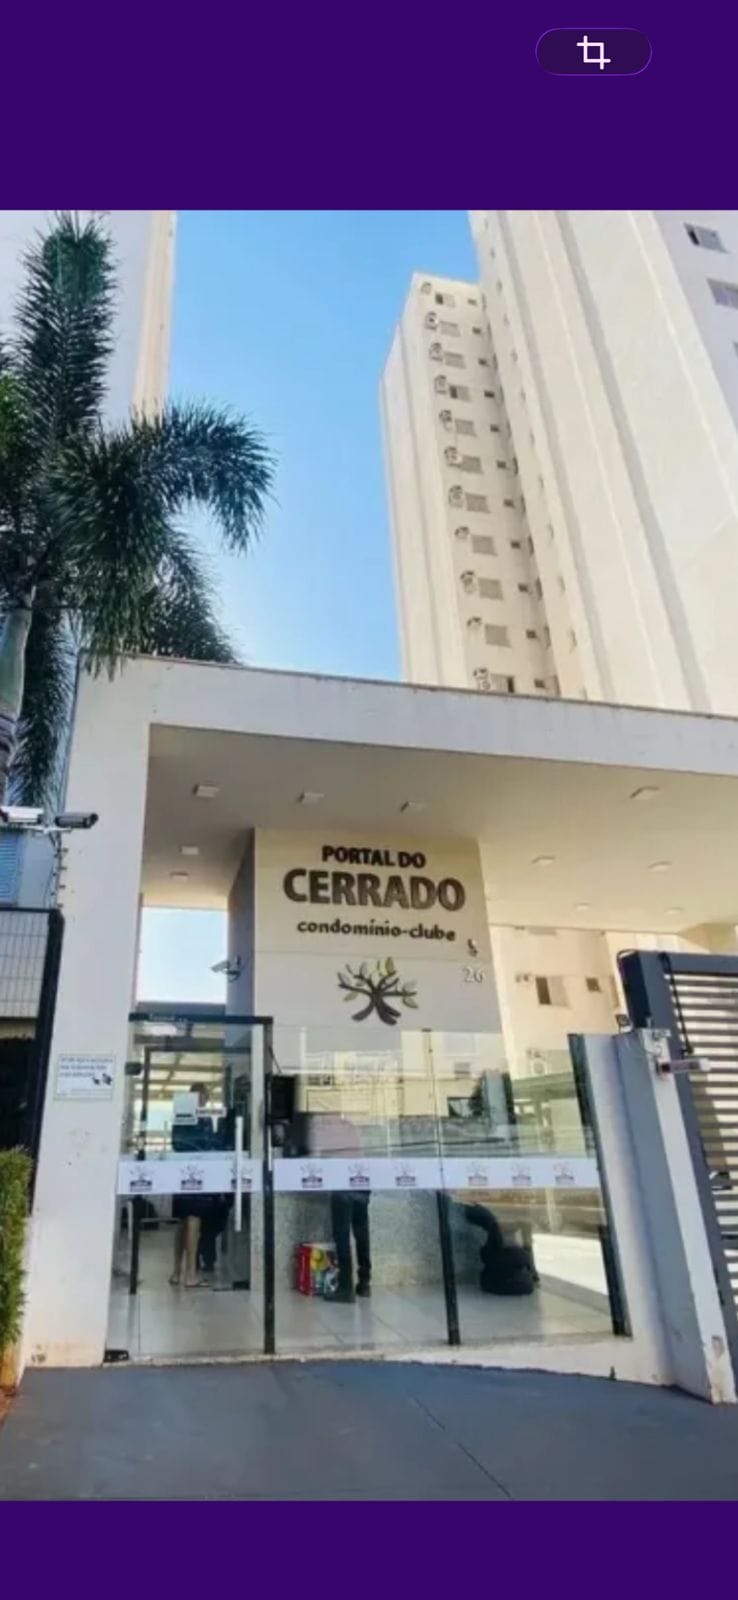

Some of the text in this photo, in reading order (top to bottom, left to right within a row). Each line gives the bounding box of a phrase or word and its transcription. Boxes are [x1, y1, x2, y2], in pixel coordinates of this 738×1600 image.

[321, 845, 426, 869] PORTAL DO
[283, 868, 466, 912] CERRADO
[296, 919, 456, 941] condomínio-clube
